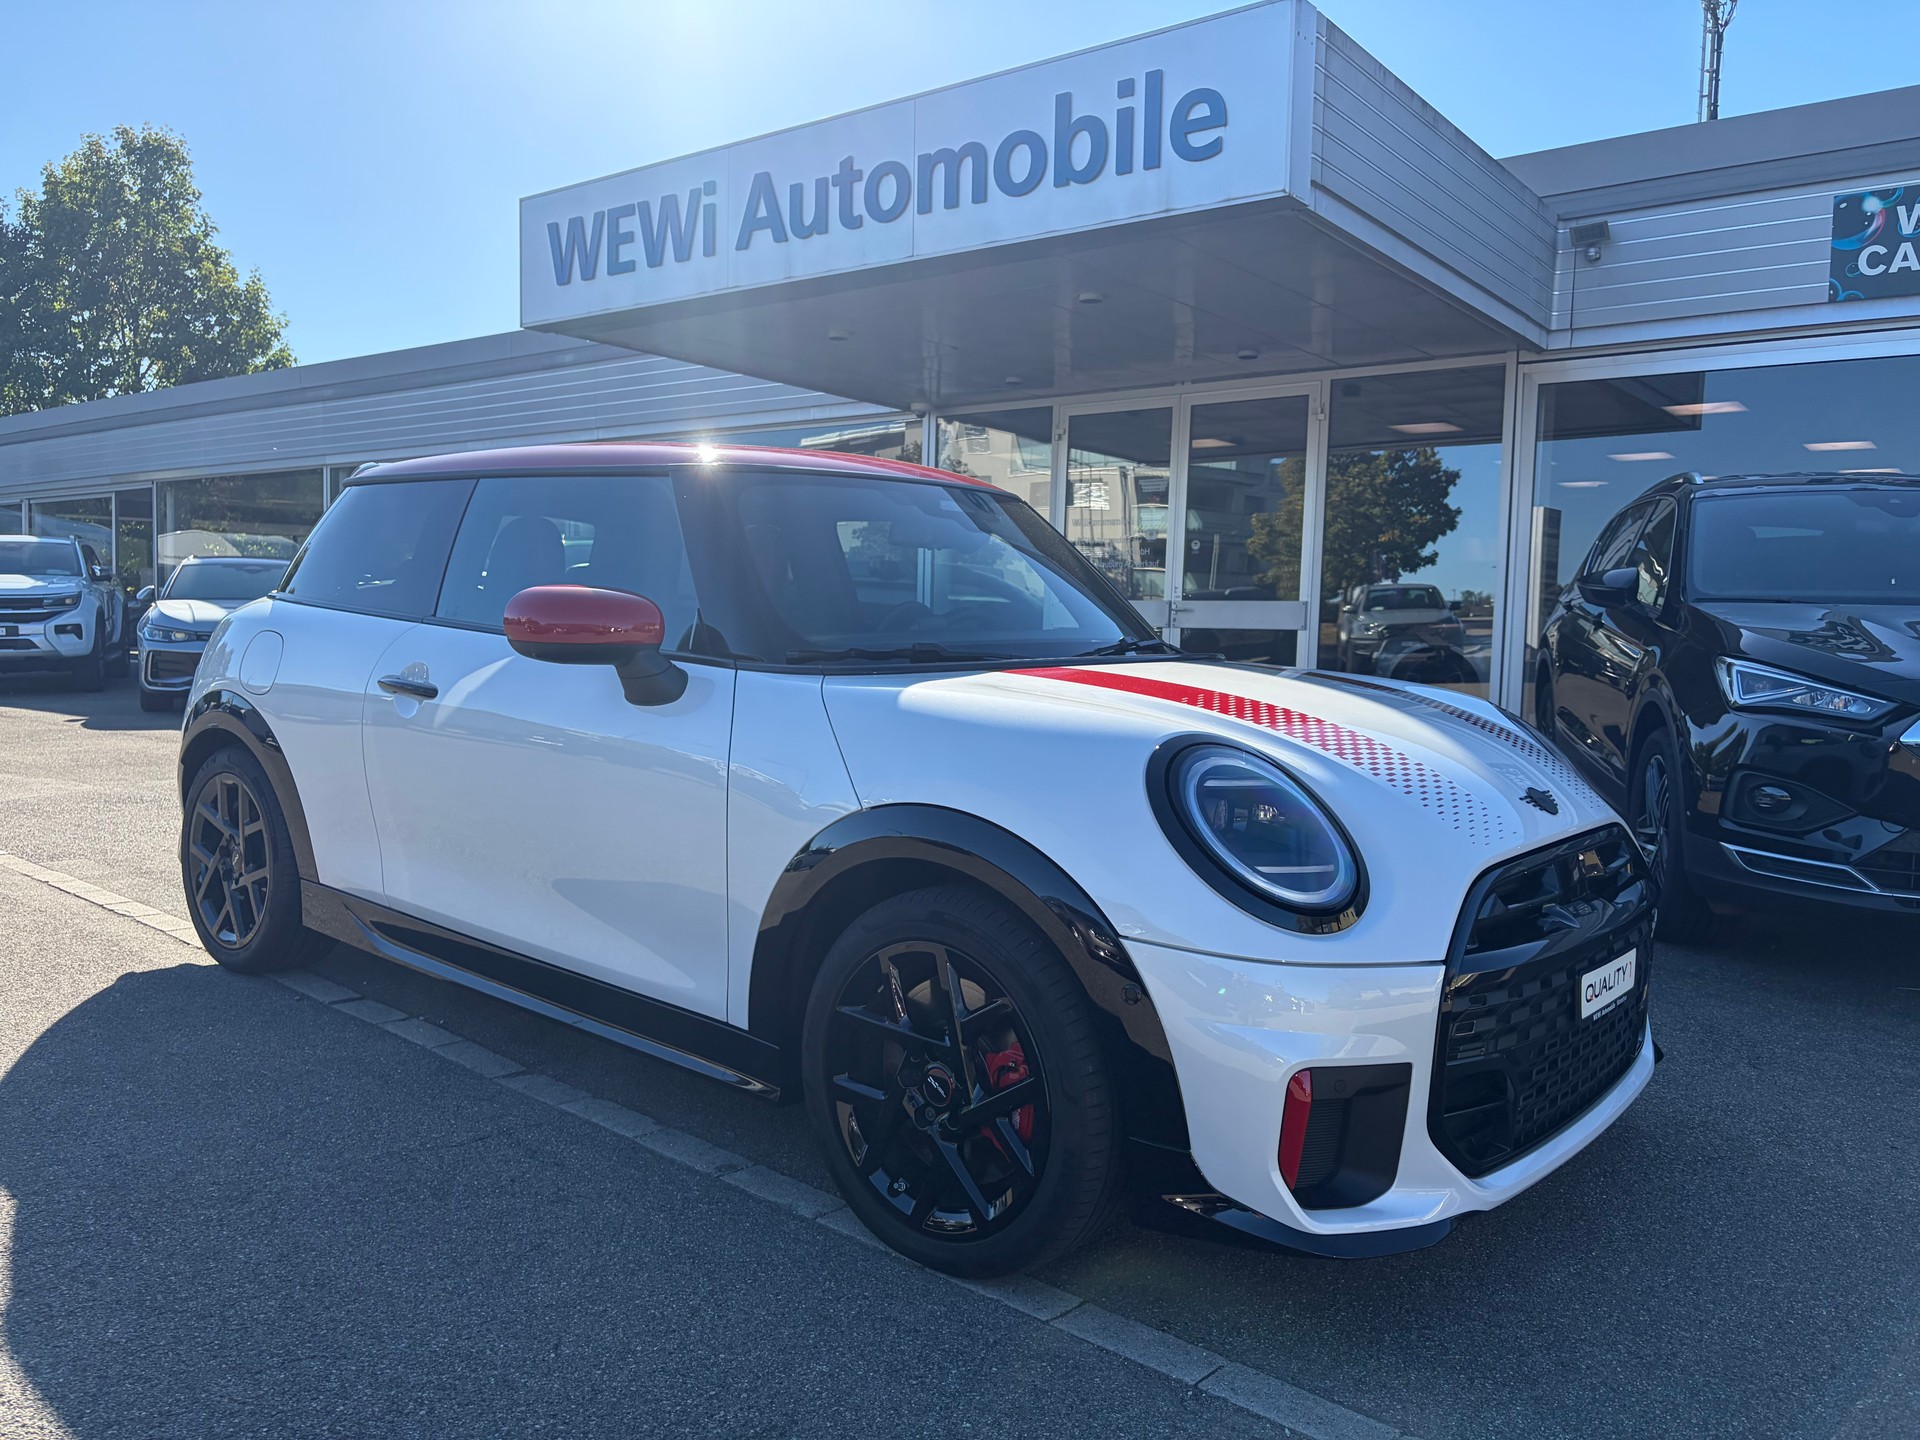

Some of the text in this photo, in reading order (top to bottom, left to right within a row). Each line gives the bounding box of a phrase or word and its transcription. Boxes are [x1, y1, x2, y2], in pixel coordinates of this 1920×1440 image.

[547, 69, 1228, 286] WEWi Automobile
[1858, 241, 1920, 276] CA
[1585, 962, 1628, 1003] QUALITY
[1629, 961, 1633, 978] 1
